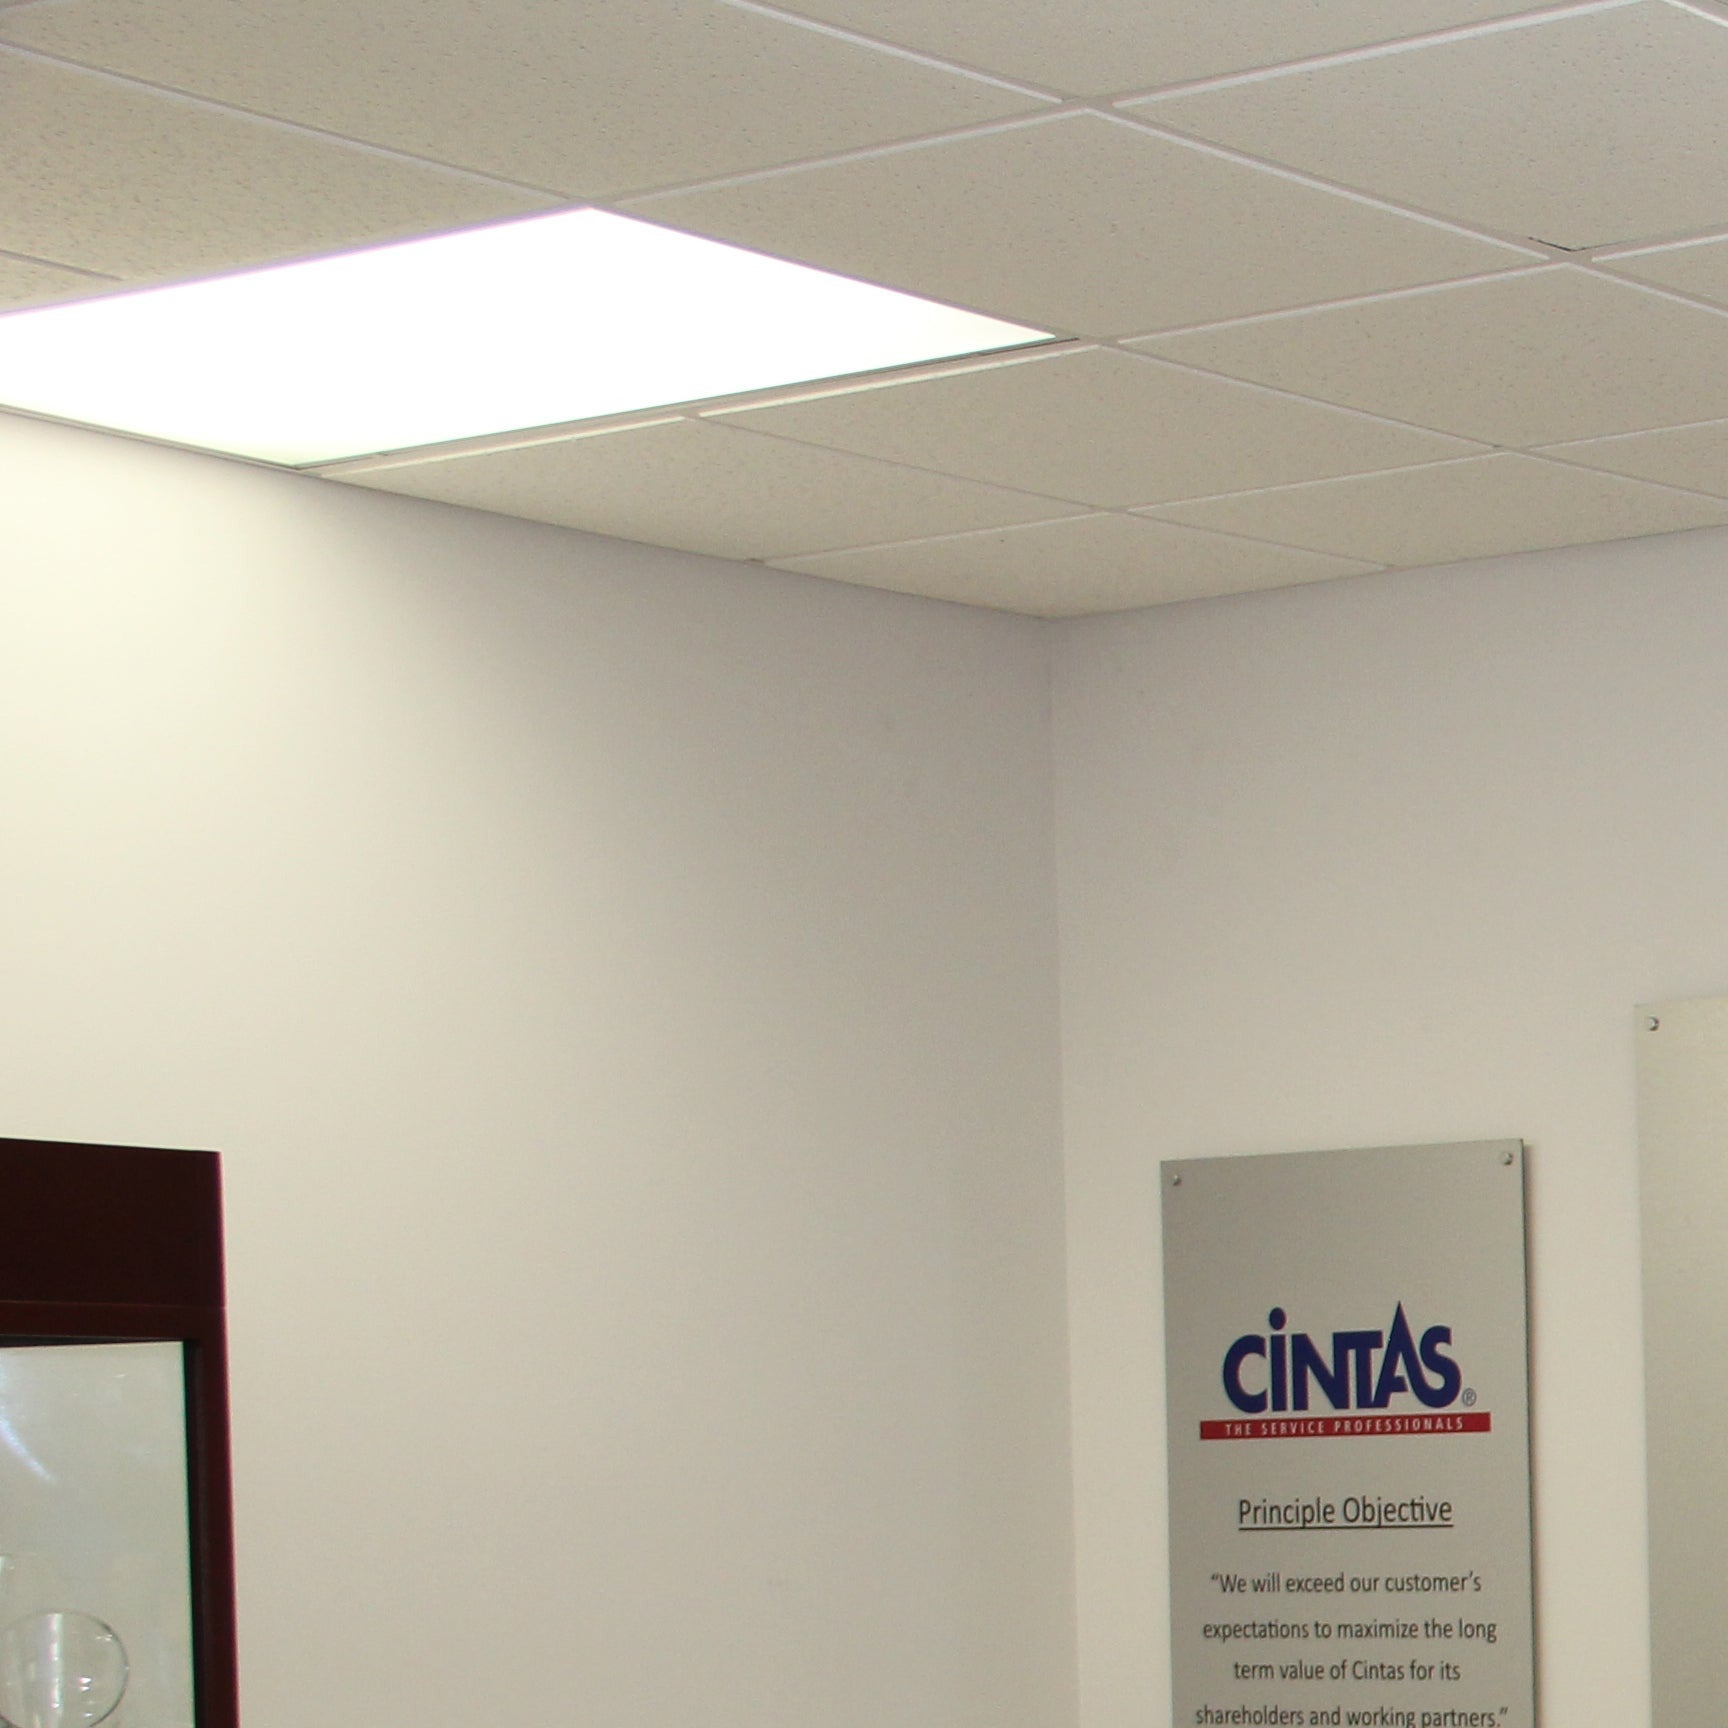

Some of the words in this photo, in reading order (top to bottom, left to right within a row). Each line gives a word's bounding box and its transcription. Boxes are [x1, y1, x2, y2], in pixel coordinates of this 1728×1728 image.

[1225, 1422, 1252, 1435] THE
[1261, 1420, 1326, 1434] SERVICE
[1334, 1418, 1464, 1432] PROFESSIONALS
[1239, 1497, 1335, 1528] Principle
[1343, 1496, 1452, 1528] Objective
[1251, 1571, 1280, 1593] will
[1286, 1572, 1344, 1594] exceed
[1349, 1578, 1380, 1592] our
[1203, 1619, 1309, 1642] expectations
[1314, 1622, 1332, 1639] to
[1338, 1619, 1418, 1639] maximize
[1424, 1618, 1452, 1639] the
[1458, 1618, 1497, 1644] long
[1233, 1661, 1274, 1681] term
[1279, 1660, 1324, 1680] value
[1329, 1659, 1347, 1680] of
[1352, 1660, 1404, 1681] Cintas
[1409, 1659, 1434, 1680] for
[1440, 1660, 1461, 1680] its
[1196, 1706, 1304, 1726] shareholders
[1309, 1706, 1341, 1726] and
